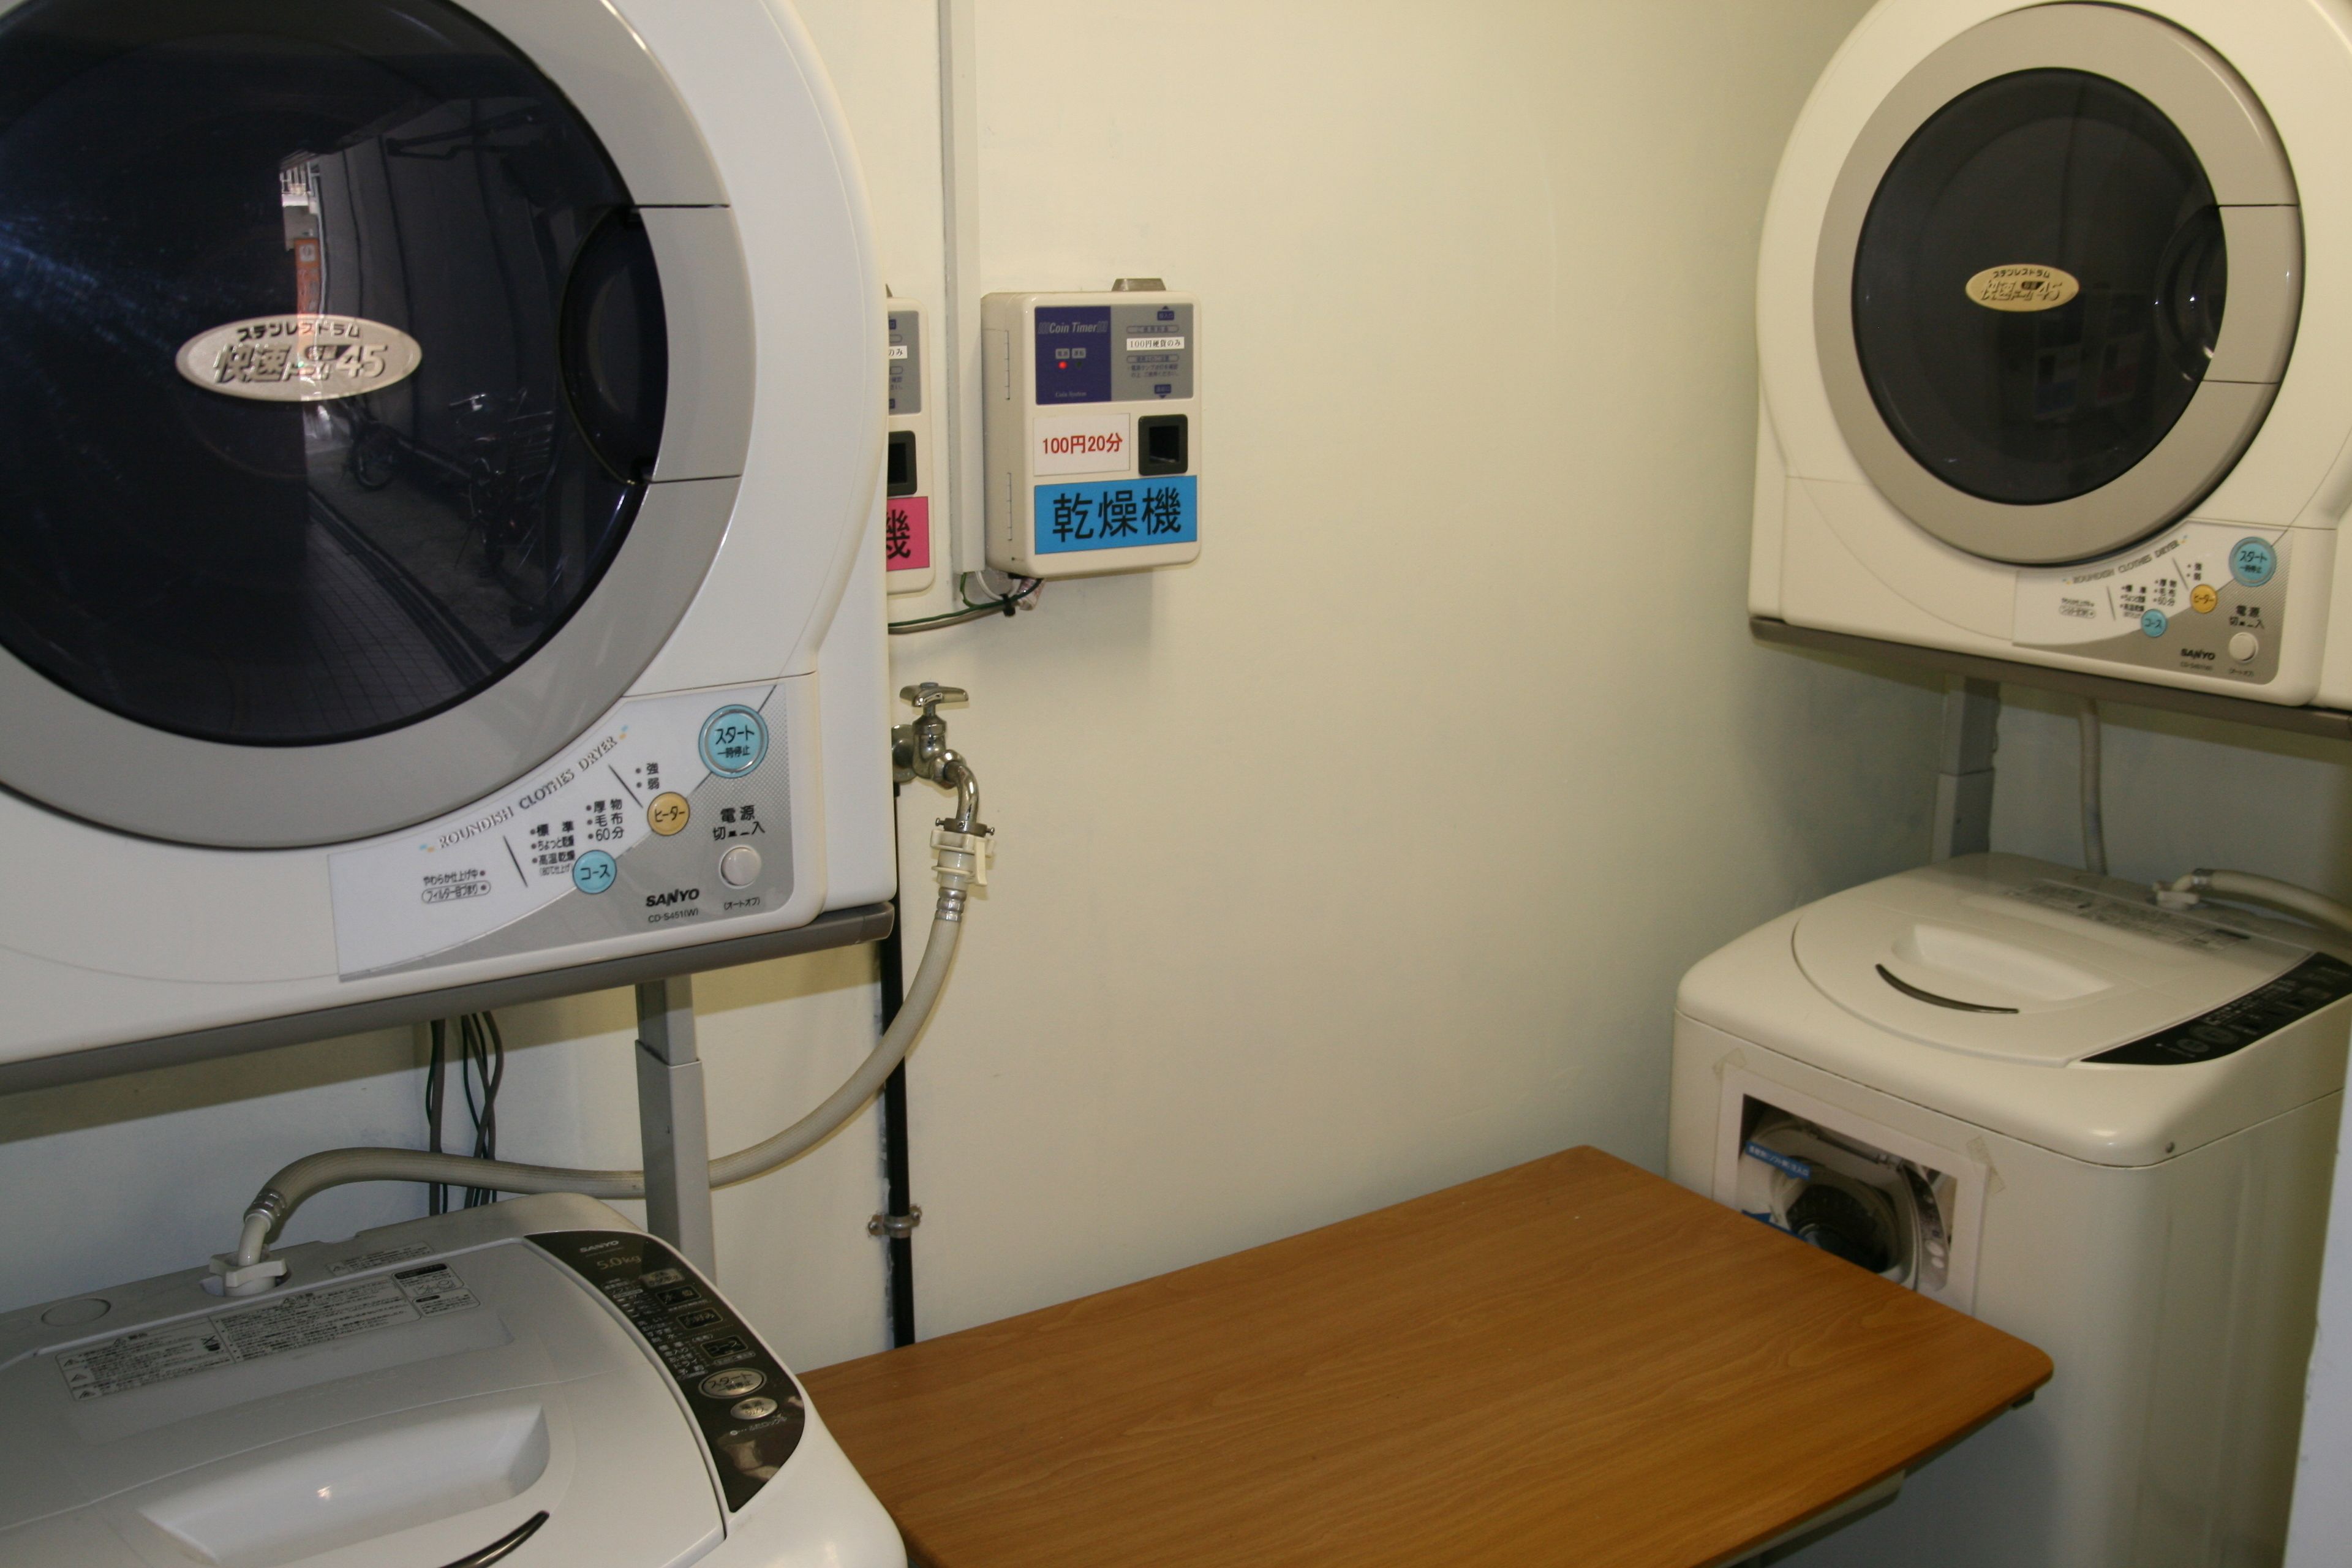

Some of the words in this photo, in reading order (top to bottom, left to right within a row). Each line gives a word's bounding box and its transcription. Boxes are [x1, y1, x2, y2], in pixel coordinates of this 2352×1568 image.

[236, 322, 360, 342] ステンレスドラム
[1049, 322, 1069, 333] Coin
[1072, 322, 1098, 333] Timer
[1130, 339, 1181, 348] 100円硬貨のみ
[1043, 432, 1123, 454] 100円20分
[1052, 486, 1182, 543] 乾燥機
[2239, 551, 2267, 563] スタート
[2144, 617, 2163, 629] コース
[2180, 648, 2215, 660] SANYO
[715, 725, 755, 745] スタート
[439, 806, 514, 848] ROUNDISH
[518, 769, 575, 809] CLOTHES
[578, 736, 617, 772] DRYER
[655, 806, 686, 823] ヒーター
[720, 805, 755, 823] 電源
[596, 826, 624, 841] 60分
[580, 864, 611, 881] コース
[646, 889, 699, 907] SANYO
[579, 1240, 619, 1253] SANYO
[709, 1373, 753, 1389] スタート
